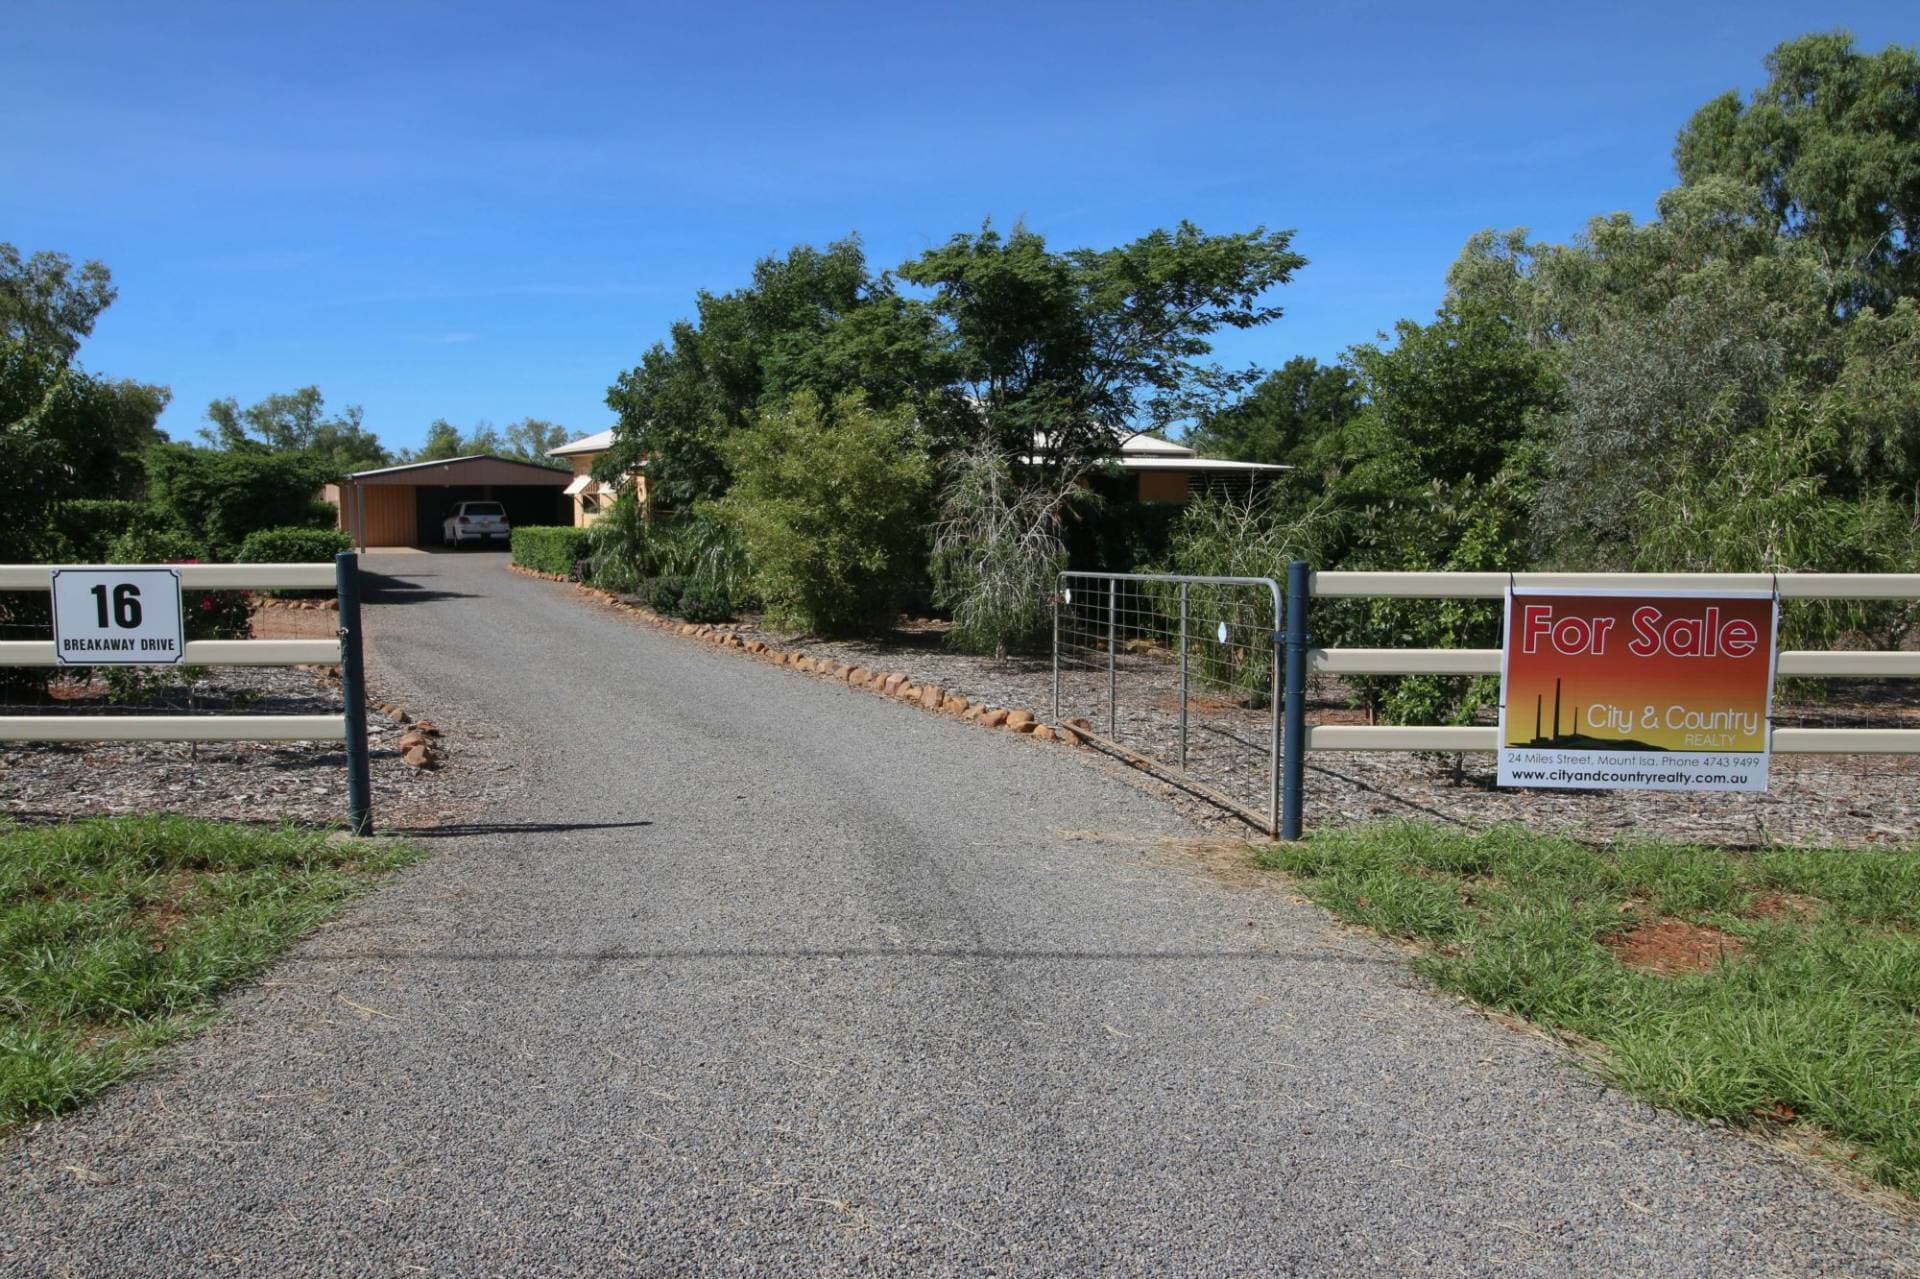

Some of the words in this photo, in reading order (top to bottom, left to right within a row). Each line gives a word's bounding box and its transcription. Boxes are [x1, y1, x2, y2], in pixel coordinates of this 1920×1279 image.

[90, 583, 142, 629] 16
[1523, 605, 1616, 655] For
[1628, 606, 1758, 657] Sale
[64, 638, 135, 651] BREAKAWAY
[141, 638, 175, 651] DRIVE
[1586, 703, 1633, 734] City
[1640, 705, 1660, 729] &
[1665, 705, 1758, 736] Country
[1685, 733, 1736, 747] REALTY
[1507, 753, 1521, 764] 24
[1525, 753, 1553, 765] Miles
[1598, 755, 1636, 766] Mount
[1662, 756, 1700, 767] Phone
[1703, 757, 1730, 768] 4743
[1733, 757, 1760, 768] 9499
[1511, 768, 1748, 786] www.cityandcountryrealty.com.au
